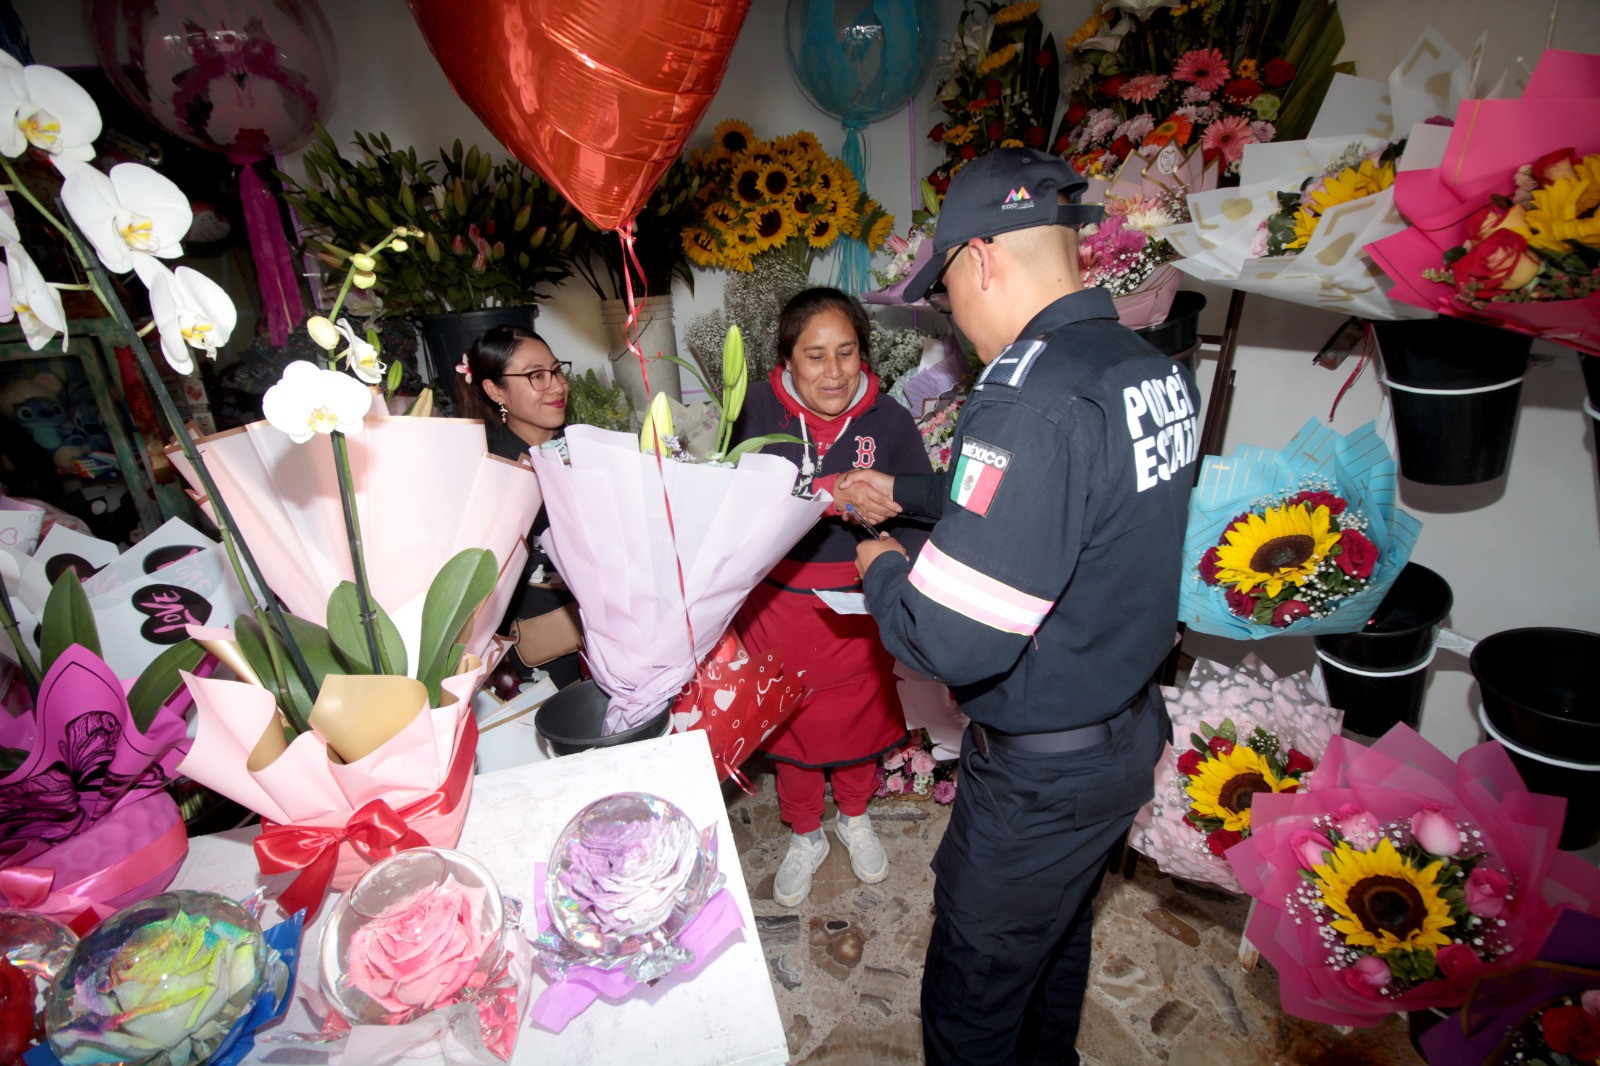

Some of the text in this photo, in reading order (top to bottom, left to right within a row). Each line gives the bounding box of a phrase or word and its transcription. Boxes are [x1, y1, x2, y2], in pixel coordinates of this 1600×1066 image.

[853, 435, 876, 468] B
[962, 443, 1007, 469] MÉXICO
[140, 589, 202, 634] LOVE
